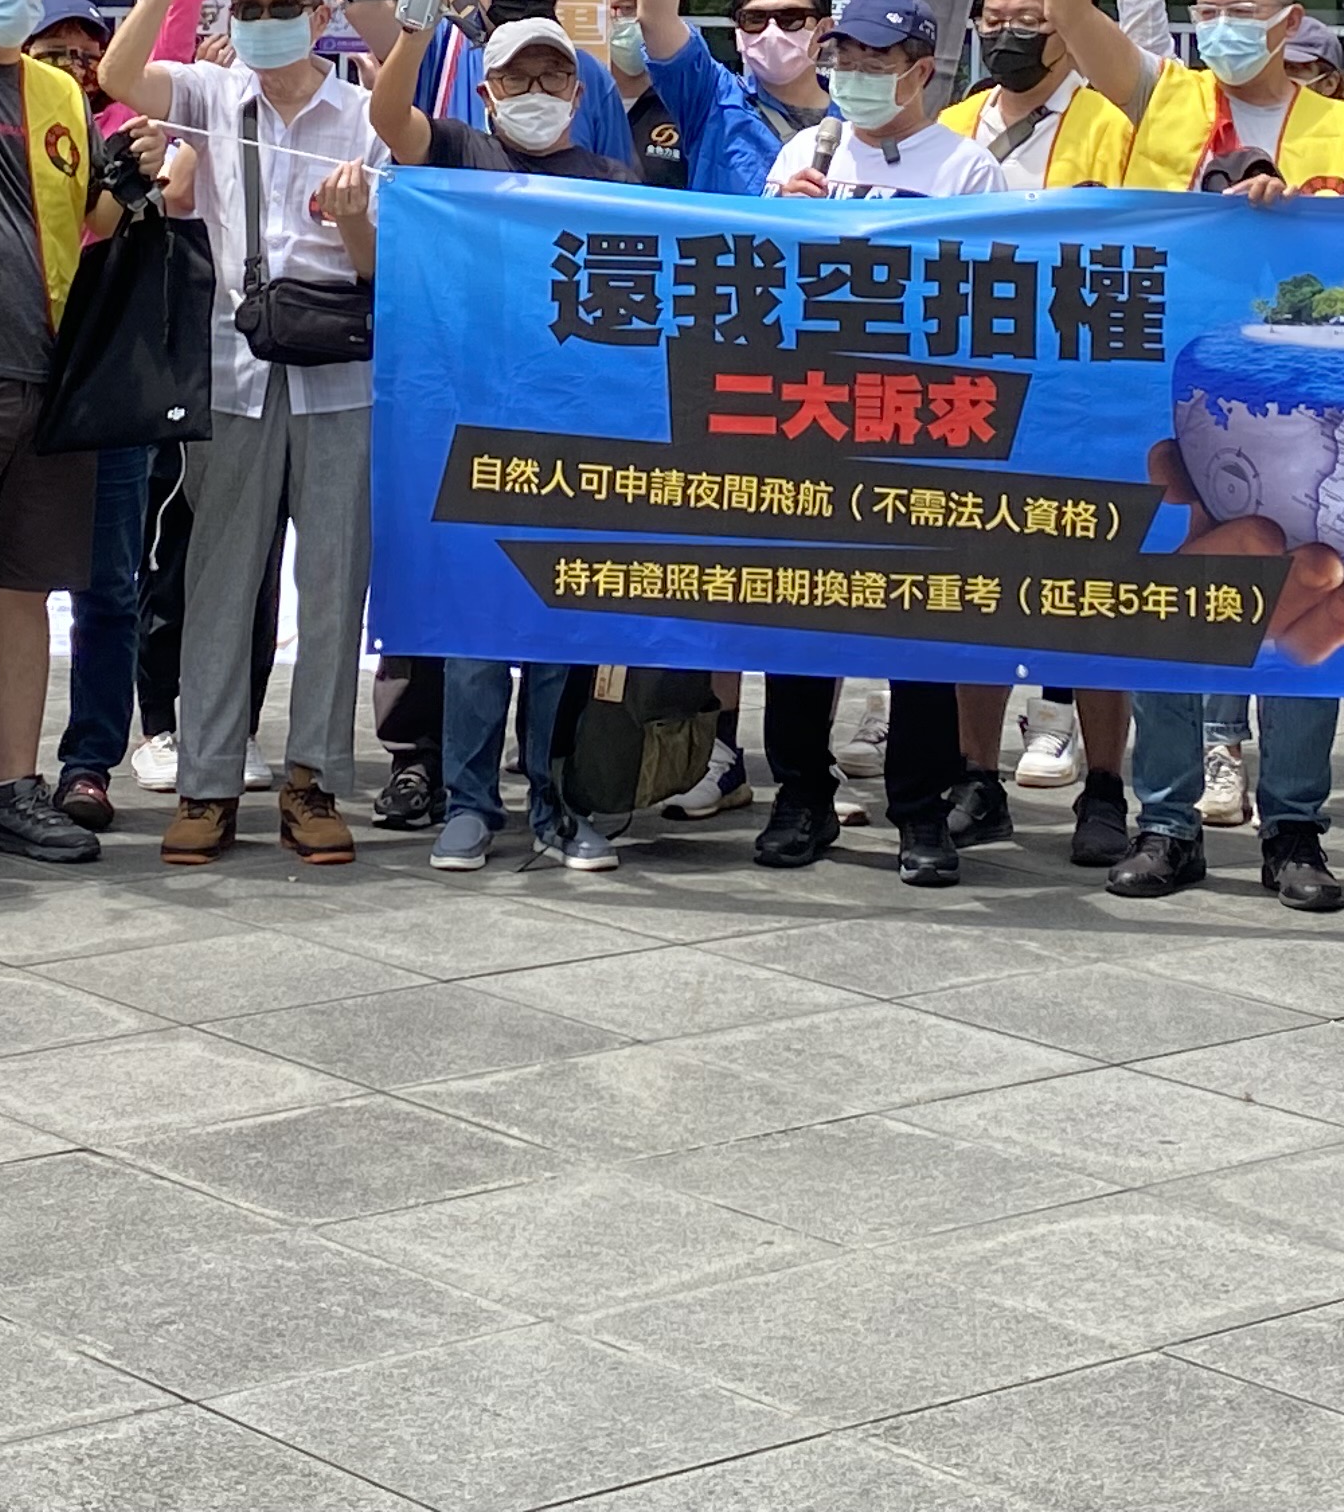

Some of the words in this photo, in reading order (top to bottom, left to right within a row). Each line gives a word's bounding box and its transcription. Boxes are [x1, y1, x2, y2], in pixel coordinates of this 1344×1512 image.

[546, 229, 1169, 363] 還我空拍權
[706, 370, 998, 447] 二大訴求
